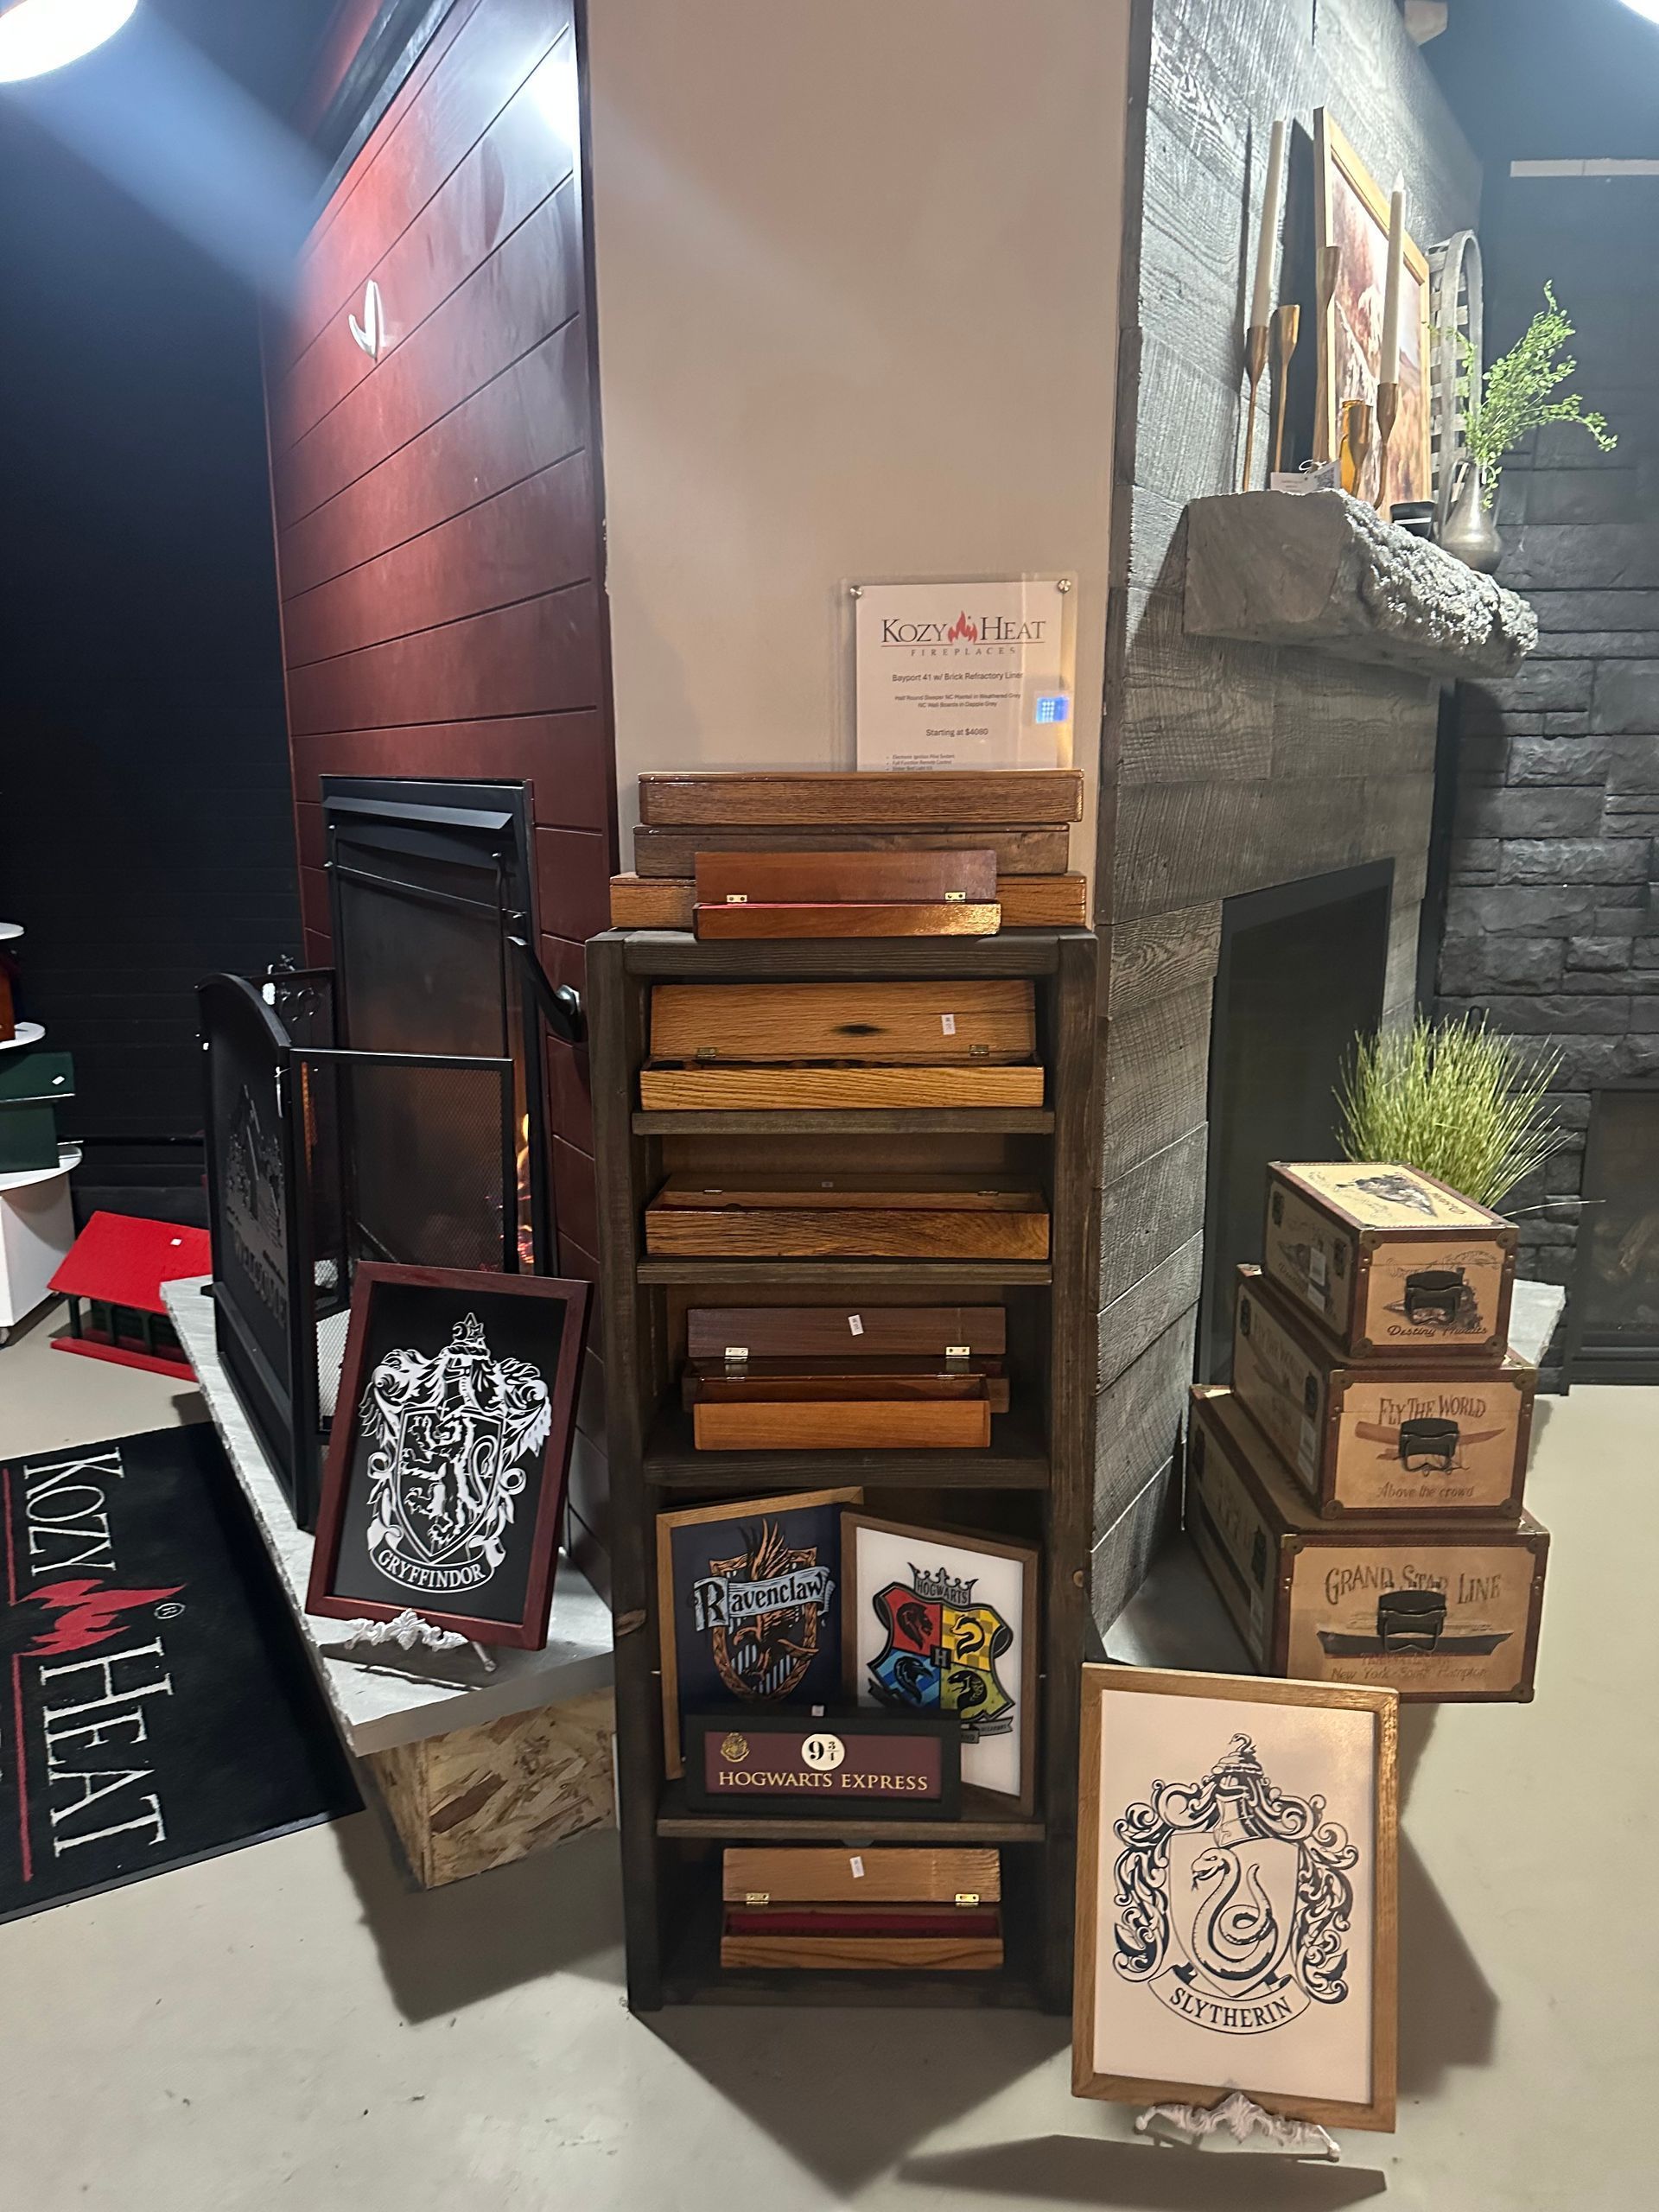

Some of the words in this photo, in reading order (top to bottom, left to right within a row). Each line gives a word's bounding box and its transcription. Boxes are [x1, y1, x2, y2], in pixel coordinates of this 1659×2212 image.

[881, 619, 947, 643] KOZY
[980, 616, 1046, 640] HEAT
[911, 647, 1016, 657] FIREPLACES
[892, 674, 921, 683] Bayport
[964, 672, 1003, 681] Refractory
[925, 728, 955, 737] Starting
[1387, 1325, 1435, 1338] Destiny
[1378, 1397, 1406, 1425] FLY
[1408, 1396, 1434, 1420] THE
[1439, 1395, 1486, 1419] WORLD
[1376, 1481, 1416, 1498] Above
[1439, 1485, 1475, 1497] crowd
[23, 1446, 125, 1576] KOZY
[378, 1549, 486, 1587] GRYFFINDOR
[917, 1580, 969, 1605] HOGWARTS
[1325, 1565, 1393, 1605] GRAND
[1400, 1564, 1449, 1592] STAR
[1457, 1573, 1502, 1605] LINE
[694, 1572, 823, 1631] Ravenclaw
[38, 1637, 175, 1858] HEAT
[719, 1771, 832, 1788] HOGWARTS
[841, 1773, 928, 1790] EXPRESS
[1169, 1987, 1293, 2027] SLYTHERIN
